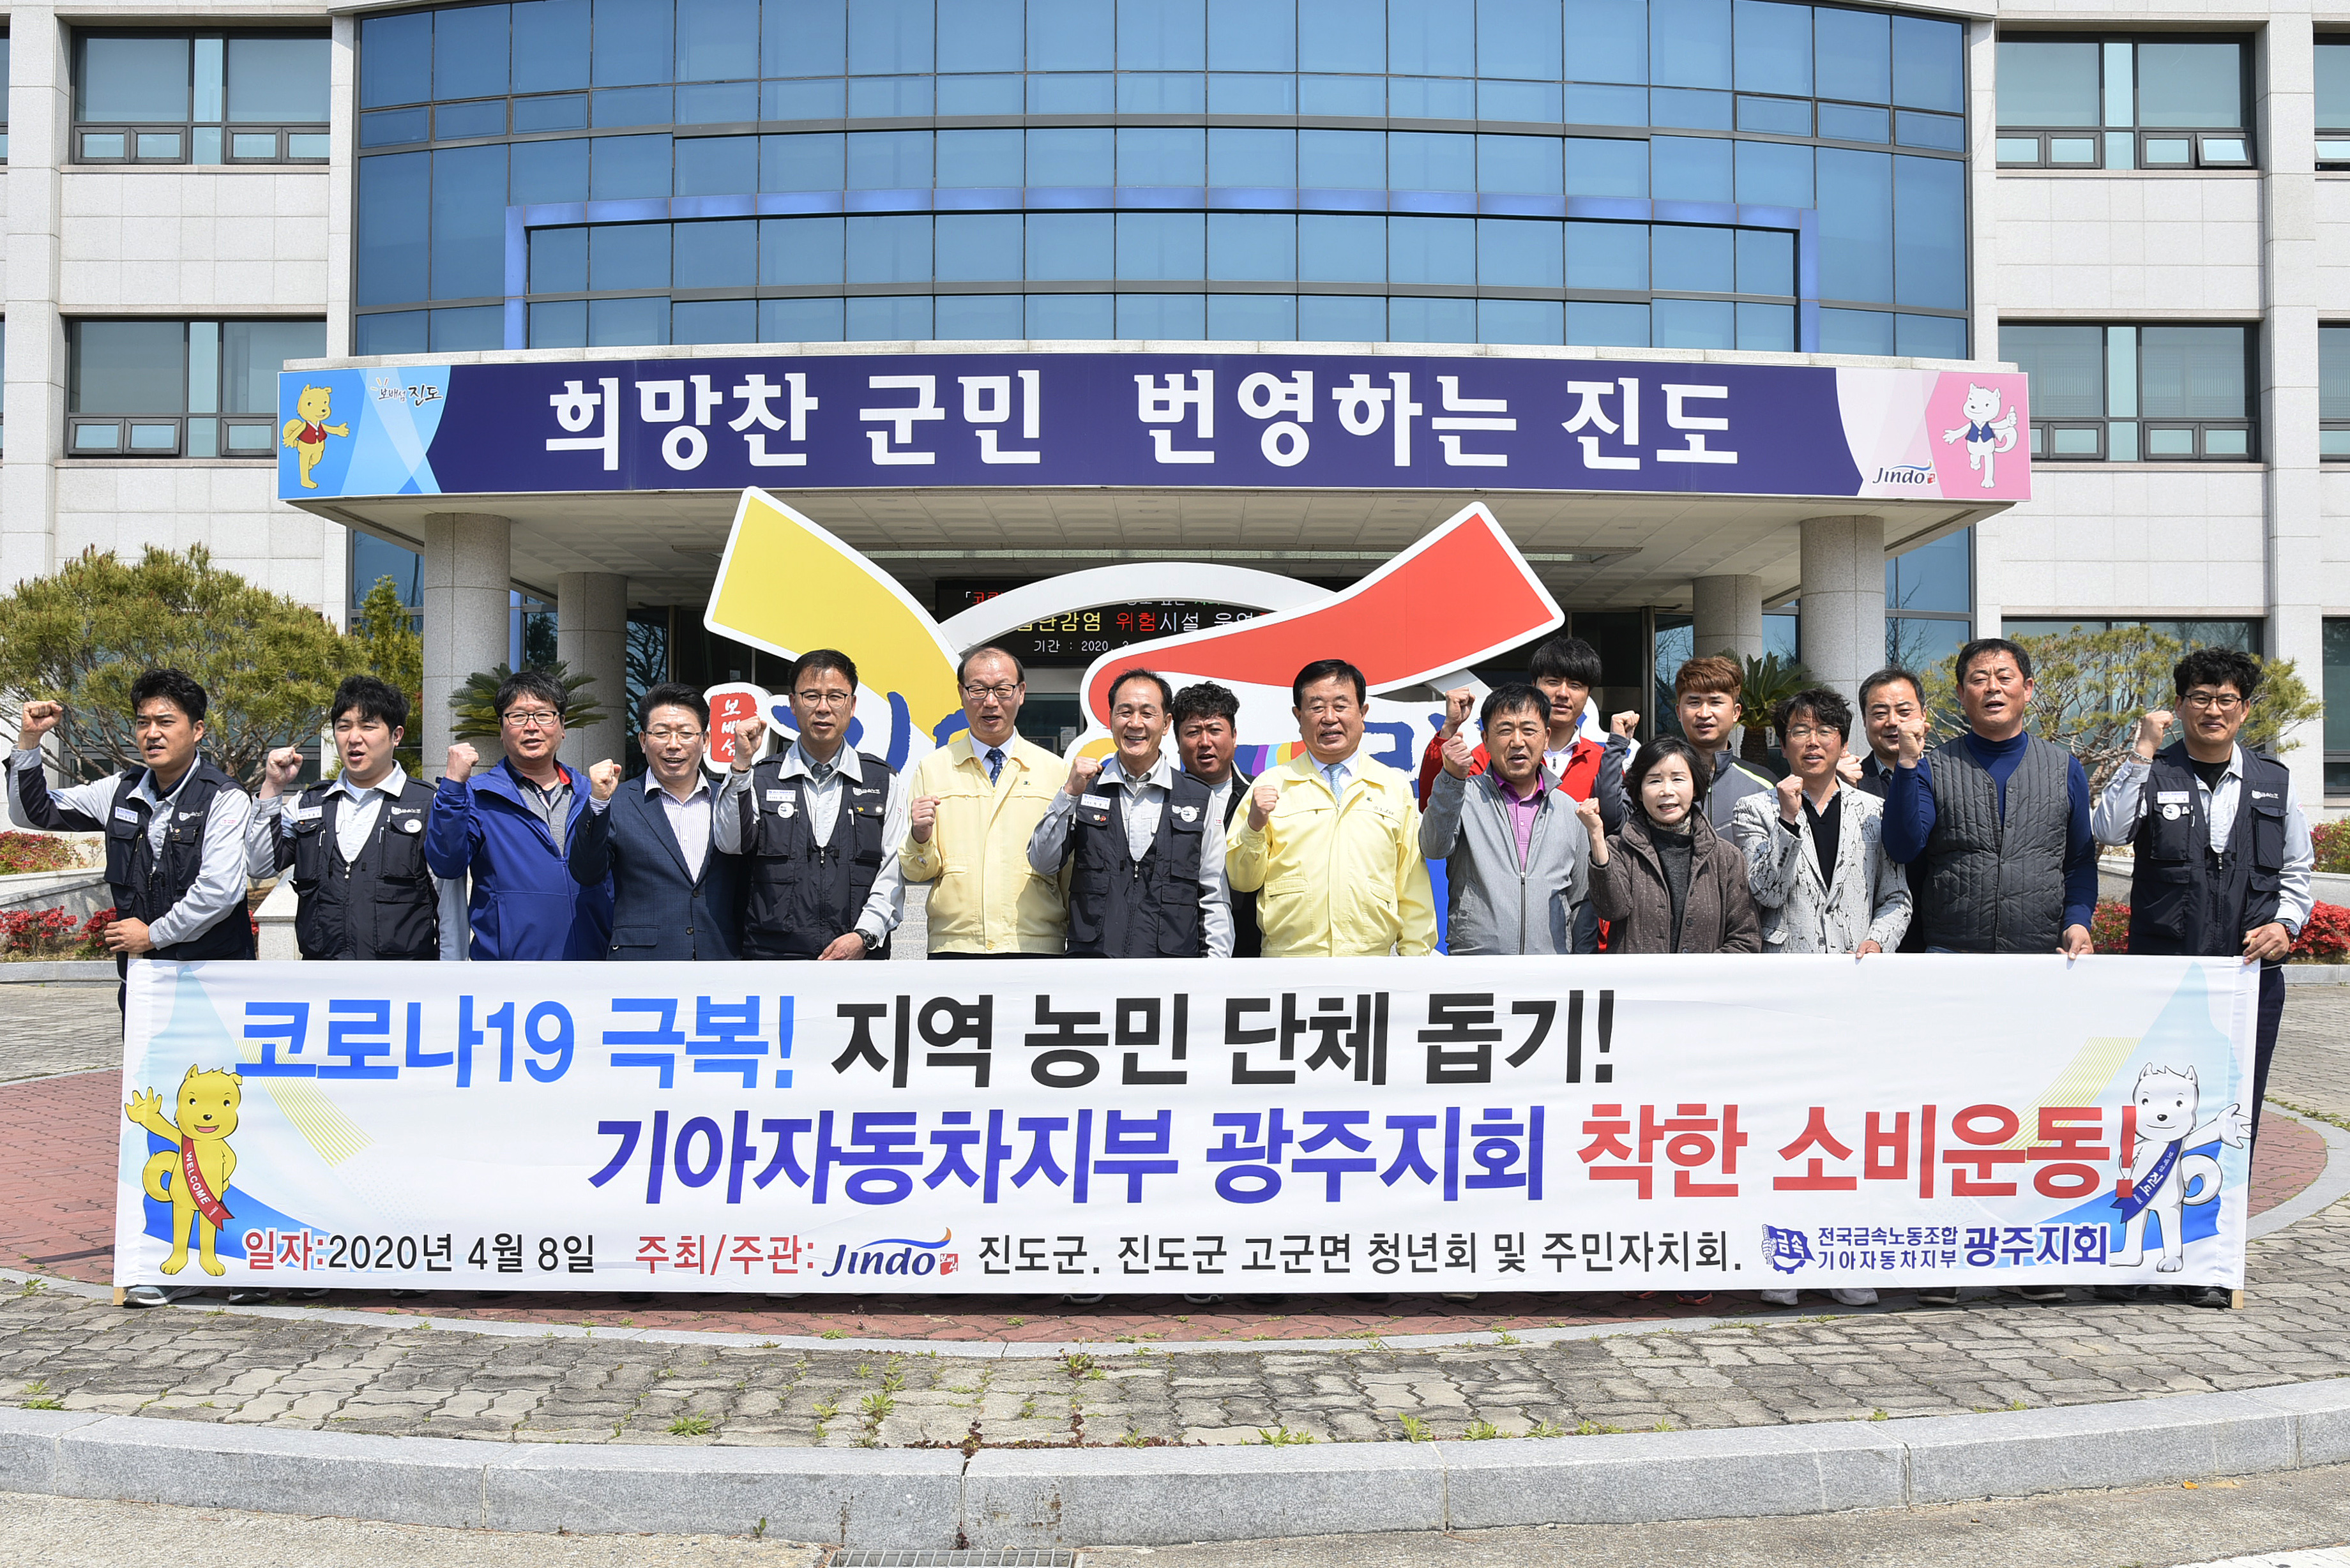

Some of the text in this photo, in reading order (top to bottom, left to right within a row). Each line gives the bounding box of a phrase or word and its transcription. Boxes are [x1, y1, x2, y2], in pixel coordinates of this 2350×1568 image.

[379, 384, 442, 406] 보배섬 진도
[547, 370, 1737, 470] 희망찬 군민 번영하는 진도
[1872, 467, 1925, 484] Jindo
[1034, 640, 1060, 652] 기간
[236, 990, 1614, 1088] 코로나19 극복! 지역 농민 단체 돕기!
[589, 1104, 2137, 1205] 기아자동차지부 광주지회 착한 소비운동!
[186, 1151, 211, 1205] WELCOME
[2139, 1172, 2164, 1197] 진도
[469, 1233, 522, 1272] 4월
[538, 1235, 593, 1272] 8일
[979, 1232, 1740, 1274] 진도군. 진도군 고군면 청년회 및 주민자치회.
[1776, 1231, 1805, 1258] 금속
[1819, 1227, 1957, 1246] 전국금속노동조합
[1965, 1226, 2107, 1267] 광주지회
[637, 1235, 813, 1275] 주최/주관:
[822, 1244, 936, 1277] Jindo
[1819, 1251, 1955, 1269] 기아자동차지부
